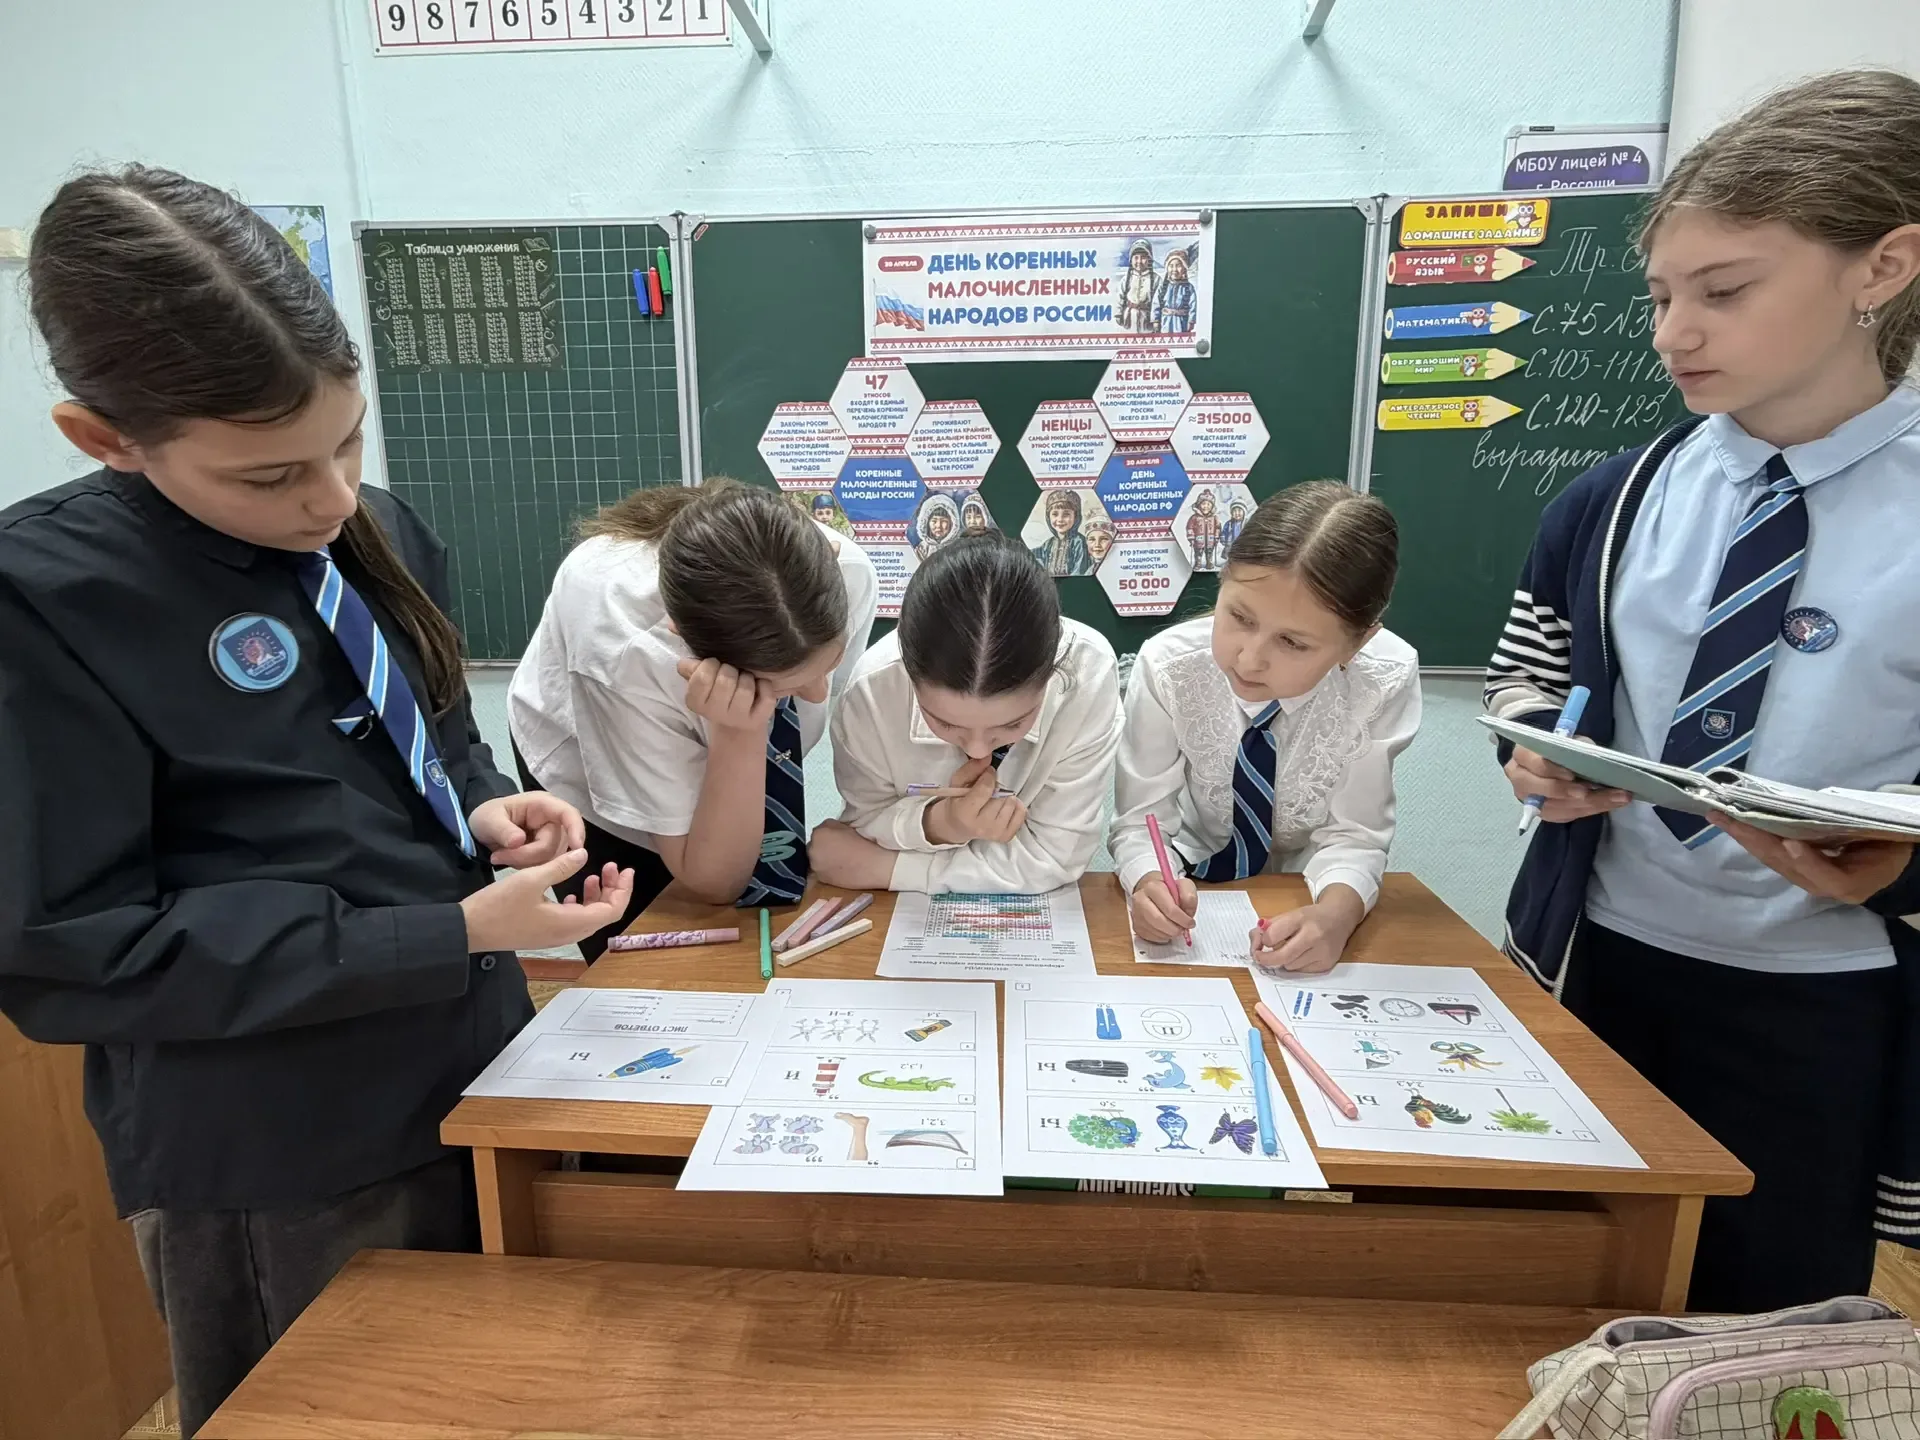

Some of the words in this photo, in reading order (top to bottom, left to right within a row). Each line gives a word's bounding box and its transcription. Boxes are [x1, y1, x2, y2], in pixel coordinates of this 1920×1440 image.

[388, 5, 405, 31] 9
[427, 2, 444, 30] 8
[464, 2, 479, 28] 7
[502, 0, 519, 26] 6
[541, 0, 558, 25] 5
[579, 0, 596, 23] 4
[618, 0, 635, 22] 3
[1515, 156, 1557, 172] МБОУ
[1561, 153, 1607, 170] лицей
[1612, 152, 1628, 165] №
[1633, 150, 1641, 163] 4
[1426, 204, 1508, 218] ЗАПИШИ
[1404, 230, 1475, 240] ДОМАШНЕЕ
[1478, 228, 1542, 238] ЗАДАНИЕ!
[405, 244, 454, 256] Таблица
[456, 243, 519, 255] умножения
[928, 252, 981, 274] ДЕНЬ
[986, 250, 1097, 270] КОРЕННЫХ
[1406, 253, 1456, 265] РУССКИЙ
[1415, 268, 1444, 276] ЯЗЫК
[928, 278, 1110, 298] МАЛОЧИСЛЕННЫХ
[928, 306, 1028, 326] НАРОДОВ
[1033, 305, 1112, 322] РОССИИ
[1396, 317, 1468, 328] МАТЕМАТИКА
[865, 375, 888, 390] 47
[1390, 403, 1460, 412] ЛИТЕРАТУРНОЕ
[1041, 418, 1092, 432] НЕНЦЫ
[856, 470, 902, 478] КОРЕННЫЕ
[1131, 470, 1155, 480] ДЕНЬ
[1119, 480, 1167, 490] КОРЕННЫХ
[842, 492, 880, 500] НАРОДЫ
[1104, 491, 1183, 502] МАЛОЧИСЛЕННЫХ
[1114, 503, 1158, 512] НАРОДОВ
[1160, 501, 1172, 510] РФ
[1119, 579, 1138, 590] 50
[1141, 578, 1170, 588] 000
[614, 1024, 660, 1032] ОТВЕТОВ
[663, 1025, 688, 1033] ЛИСТ
[1037, 1061, 1056, 1071] Ы
[1040, 1117, 1060, 1129] Ы
